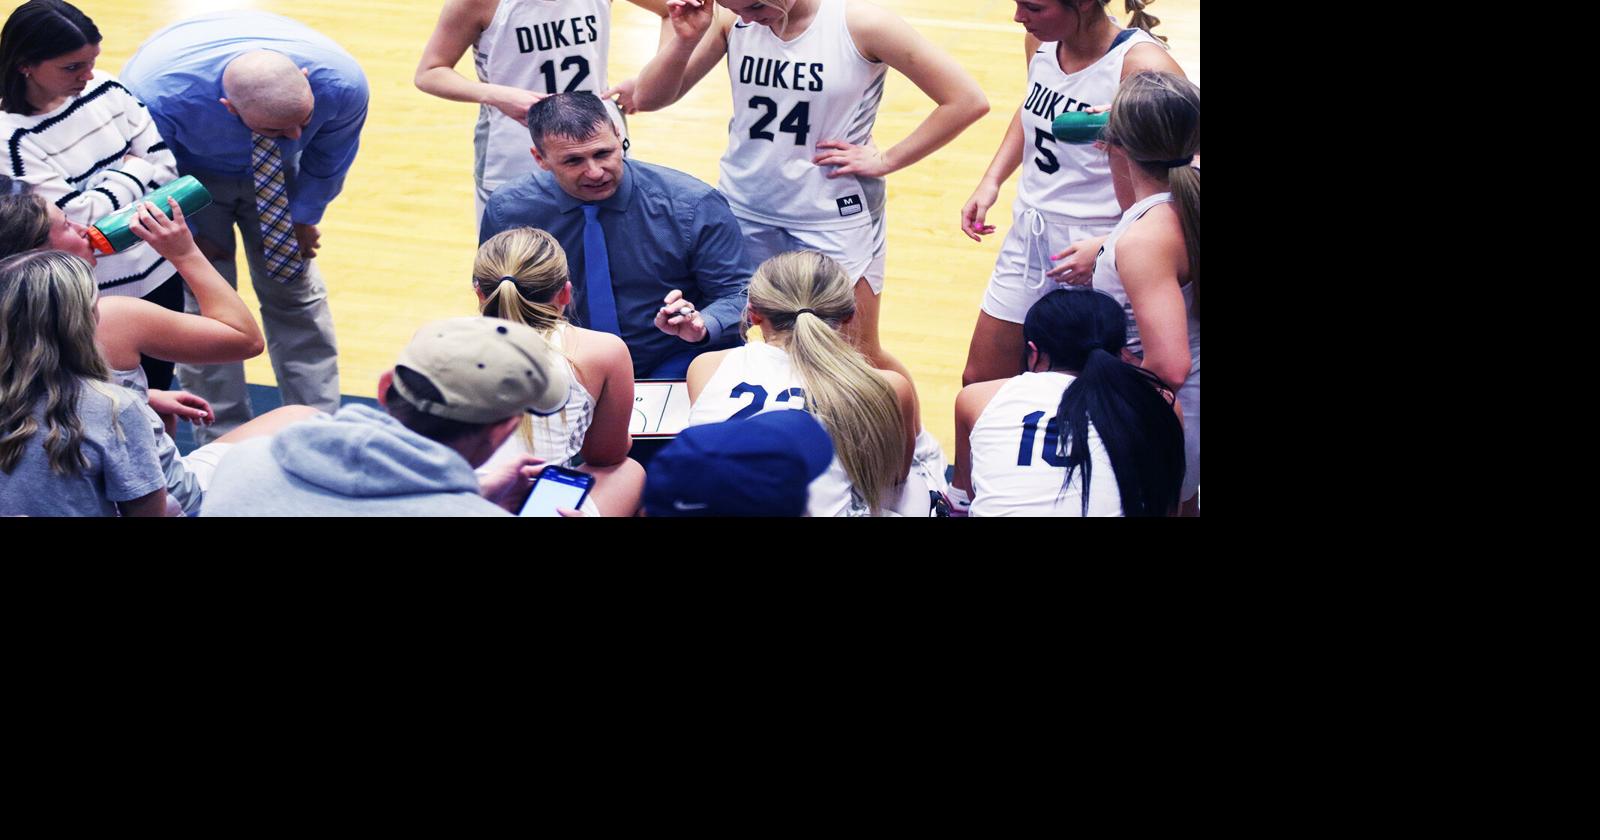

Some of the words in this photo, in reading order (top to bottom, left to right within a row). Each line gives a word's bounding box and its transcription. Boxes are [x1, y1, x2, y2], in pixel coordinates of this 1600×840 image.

[516, 15, 597, 54] DUKES
[540, 55, 593, 94] 12
[740, 56, 823, 92] DUKES
[748, 95, 811, 146] 24
[1034, 127, 1060, 175] 5
